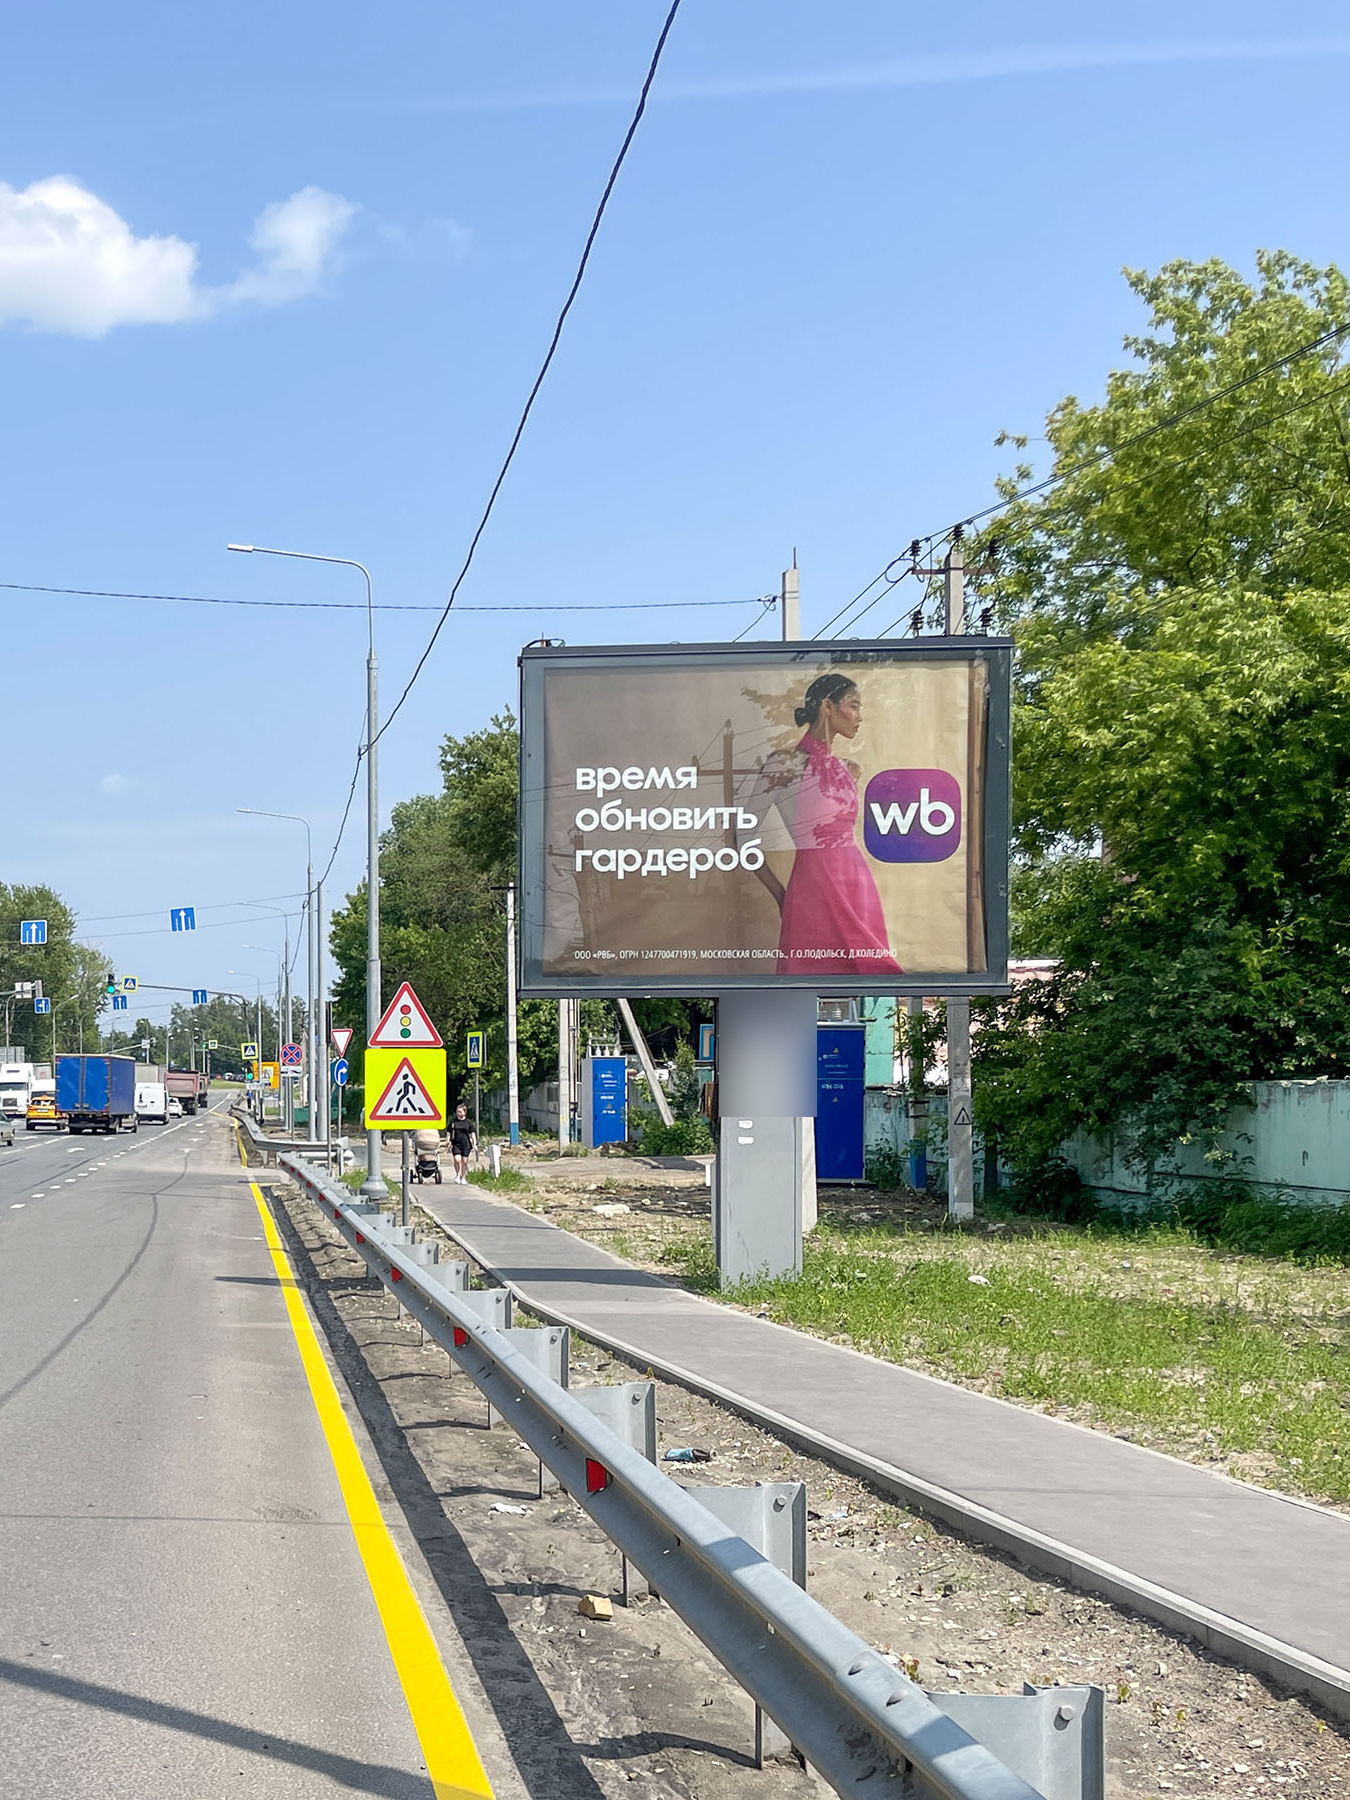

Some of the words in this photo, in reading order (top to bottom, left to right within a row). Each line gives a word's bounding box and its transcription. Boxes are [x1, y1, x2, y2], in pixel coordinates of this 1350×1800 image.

[575, 766, 697, 798] время
[574, 798, 759, 832] обновить
[870, 788, 955, 835] wb
[574, 838, 765, 879] гардероб
[574, 950, 591, 960] ООО
[592, 950, 618, 960] «РВБ»,
[619, 950, 639, 960] ОГРН
[641, 949, 699, 960] 1247700471919,
[700, 949, 750, 959] МОСКОВСКАЯ
[848, 948, 897, 960] Д.КОЛЕДИНО
